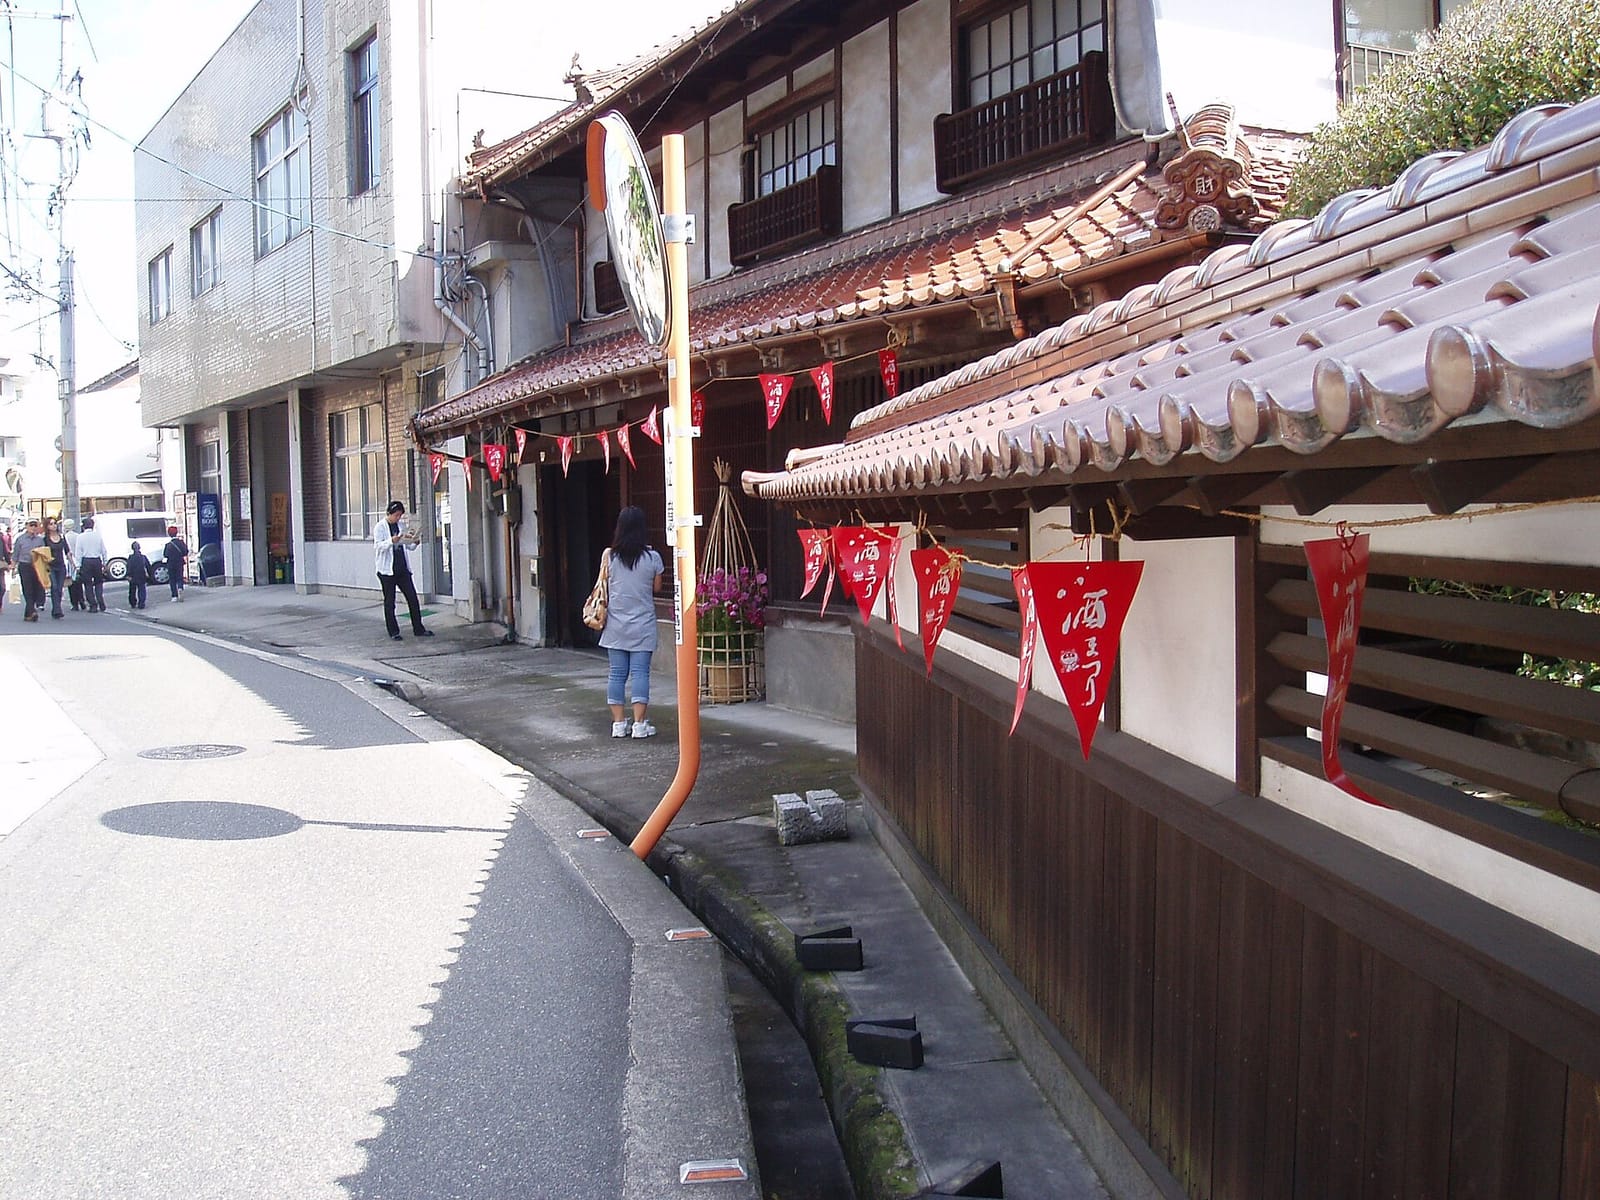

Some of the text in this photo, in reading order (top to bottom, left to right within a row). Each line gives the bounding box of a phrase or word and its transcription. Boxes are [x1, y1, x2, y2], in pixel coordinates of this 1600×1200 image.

[1195, 177, 1213, 195] 財
[767, 378, 783, 417] 酒まつり
[819, 370, 831, 410] 酒まつり
[807, 534, 822, 583] 酒まつり
[848, 534, 880, 599] 酒まつり
[925, 559, 951, 646] 酒まつり
[1056, 576, 1108, 706] 酒まつり
